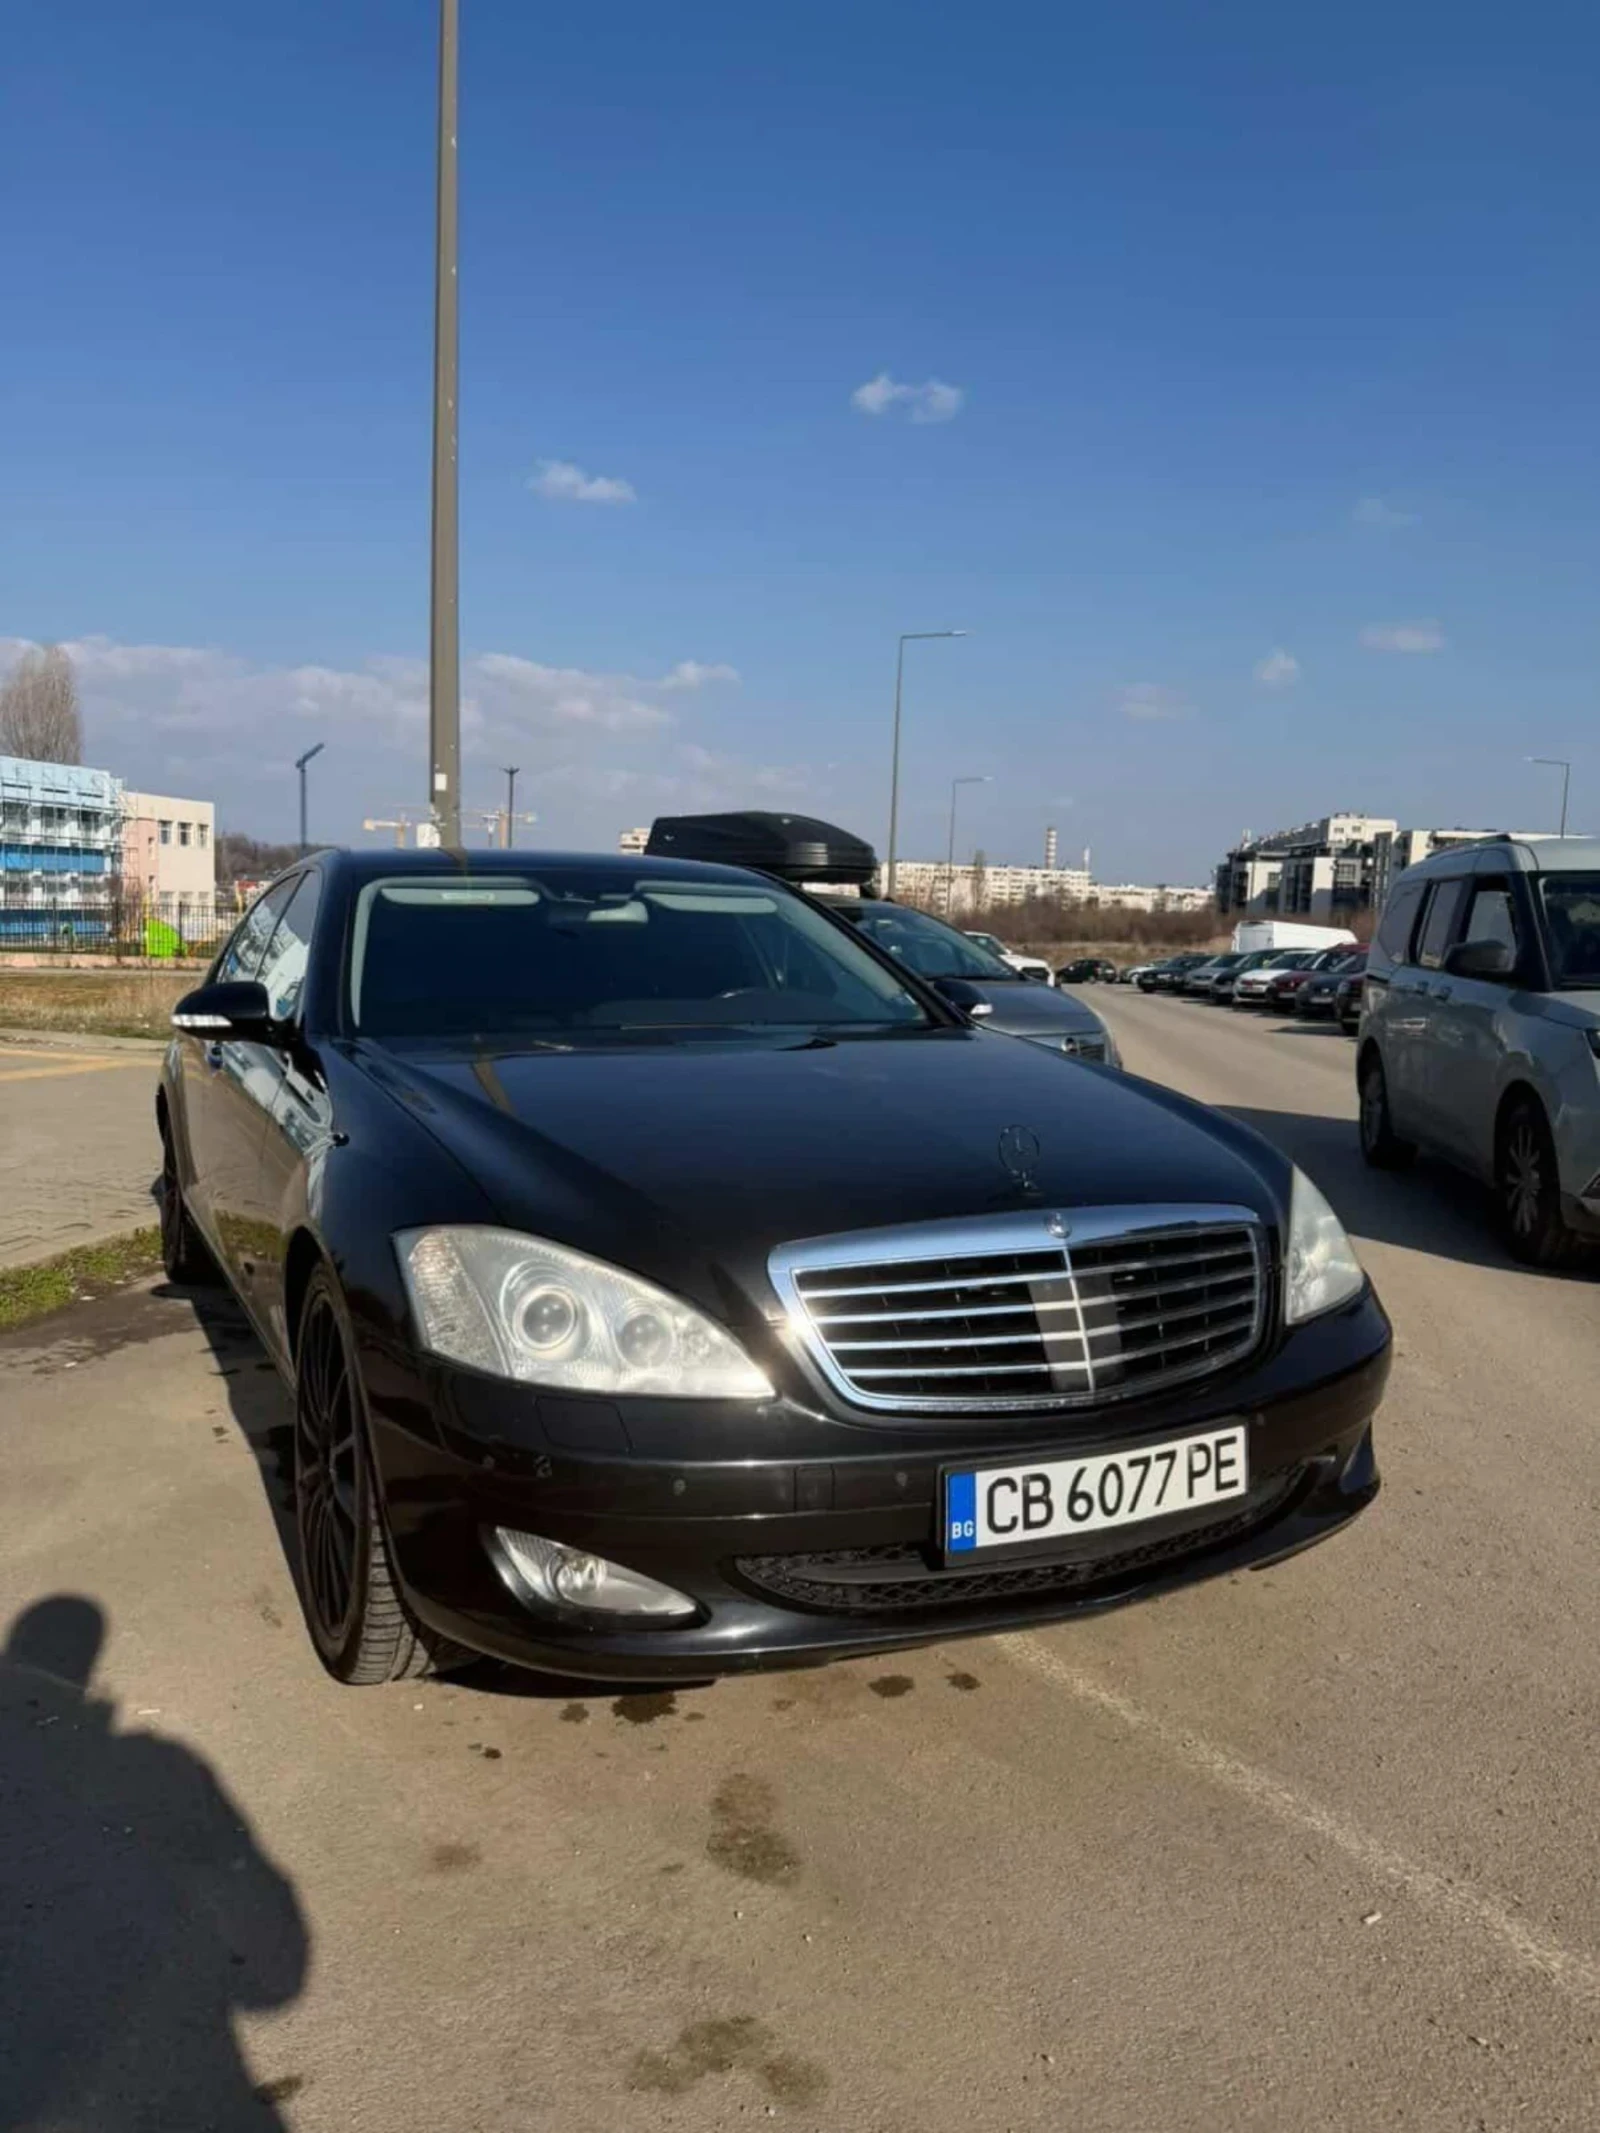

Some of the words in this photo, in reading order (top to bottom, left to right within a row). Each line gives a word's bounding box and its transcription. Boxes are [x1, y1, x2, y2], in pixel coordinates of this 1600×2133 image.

[987, 1472, 1053, 1534] CB
[1067, 1450, 1177, 1522] 6077
[1187, 1436, 1238, 1498] PE
[951, 1521, 974, 1539] BG
